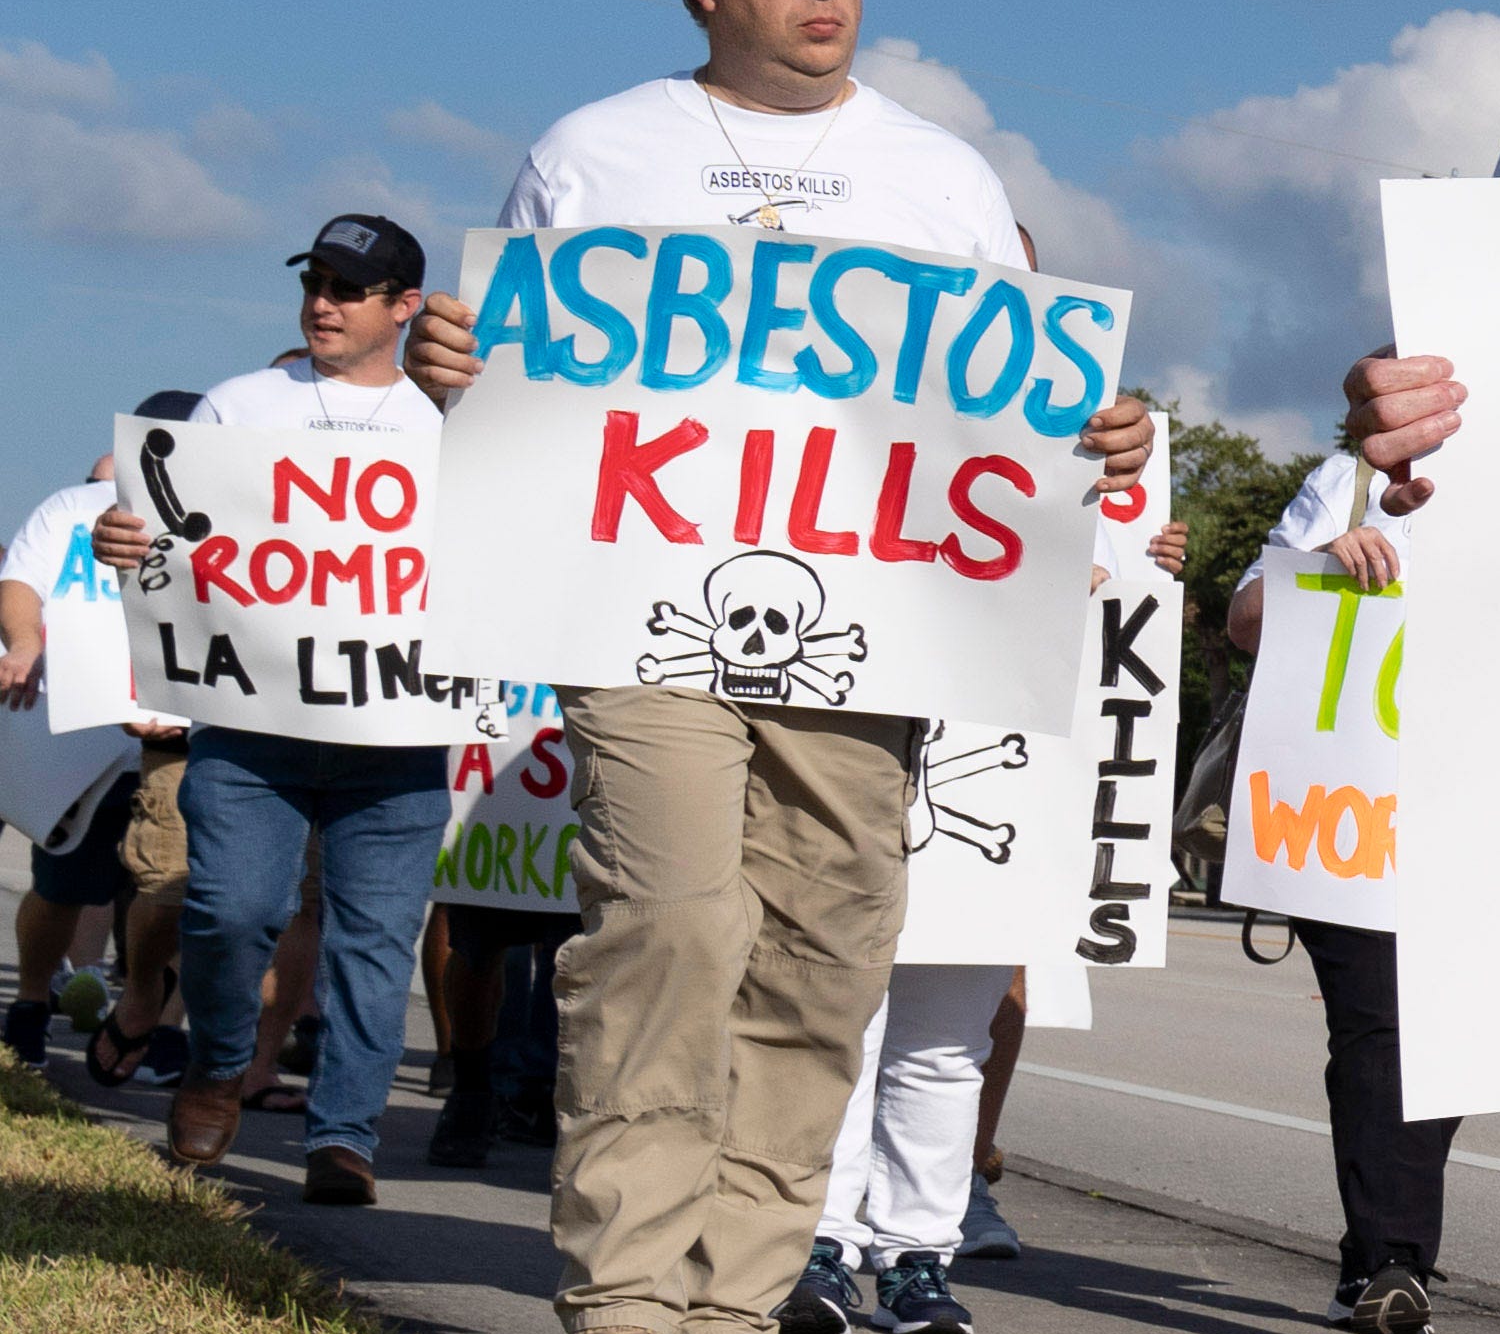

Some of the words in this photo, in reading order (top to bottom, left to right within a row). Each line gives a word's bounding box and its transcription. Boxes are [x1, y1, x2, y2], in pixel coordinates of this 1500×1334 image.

[709, 171, 793, 191] ASBESTOS
[797, 176, 846, 197] KILLS!
[476, 226, 1115, 438] ASBESTOS
[273, 456, 418, 531] NO
[591, 410, 1037, 581] KILLS
[190, 535, 430, 615] ROMP
[157, 621, 258, 696] LA
[1075, 593, 1166, 966] KILLS
